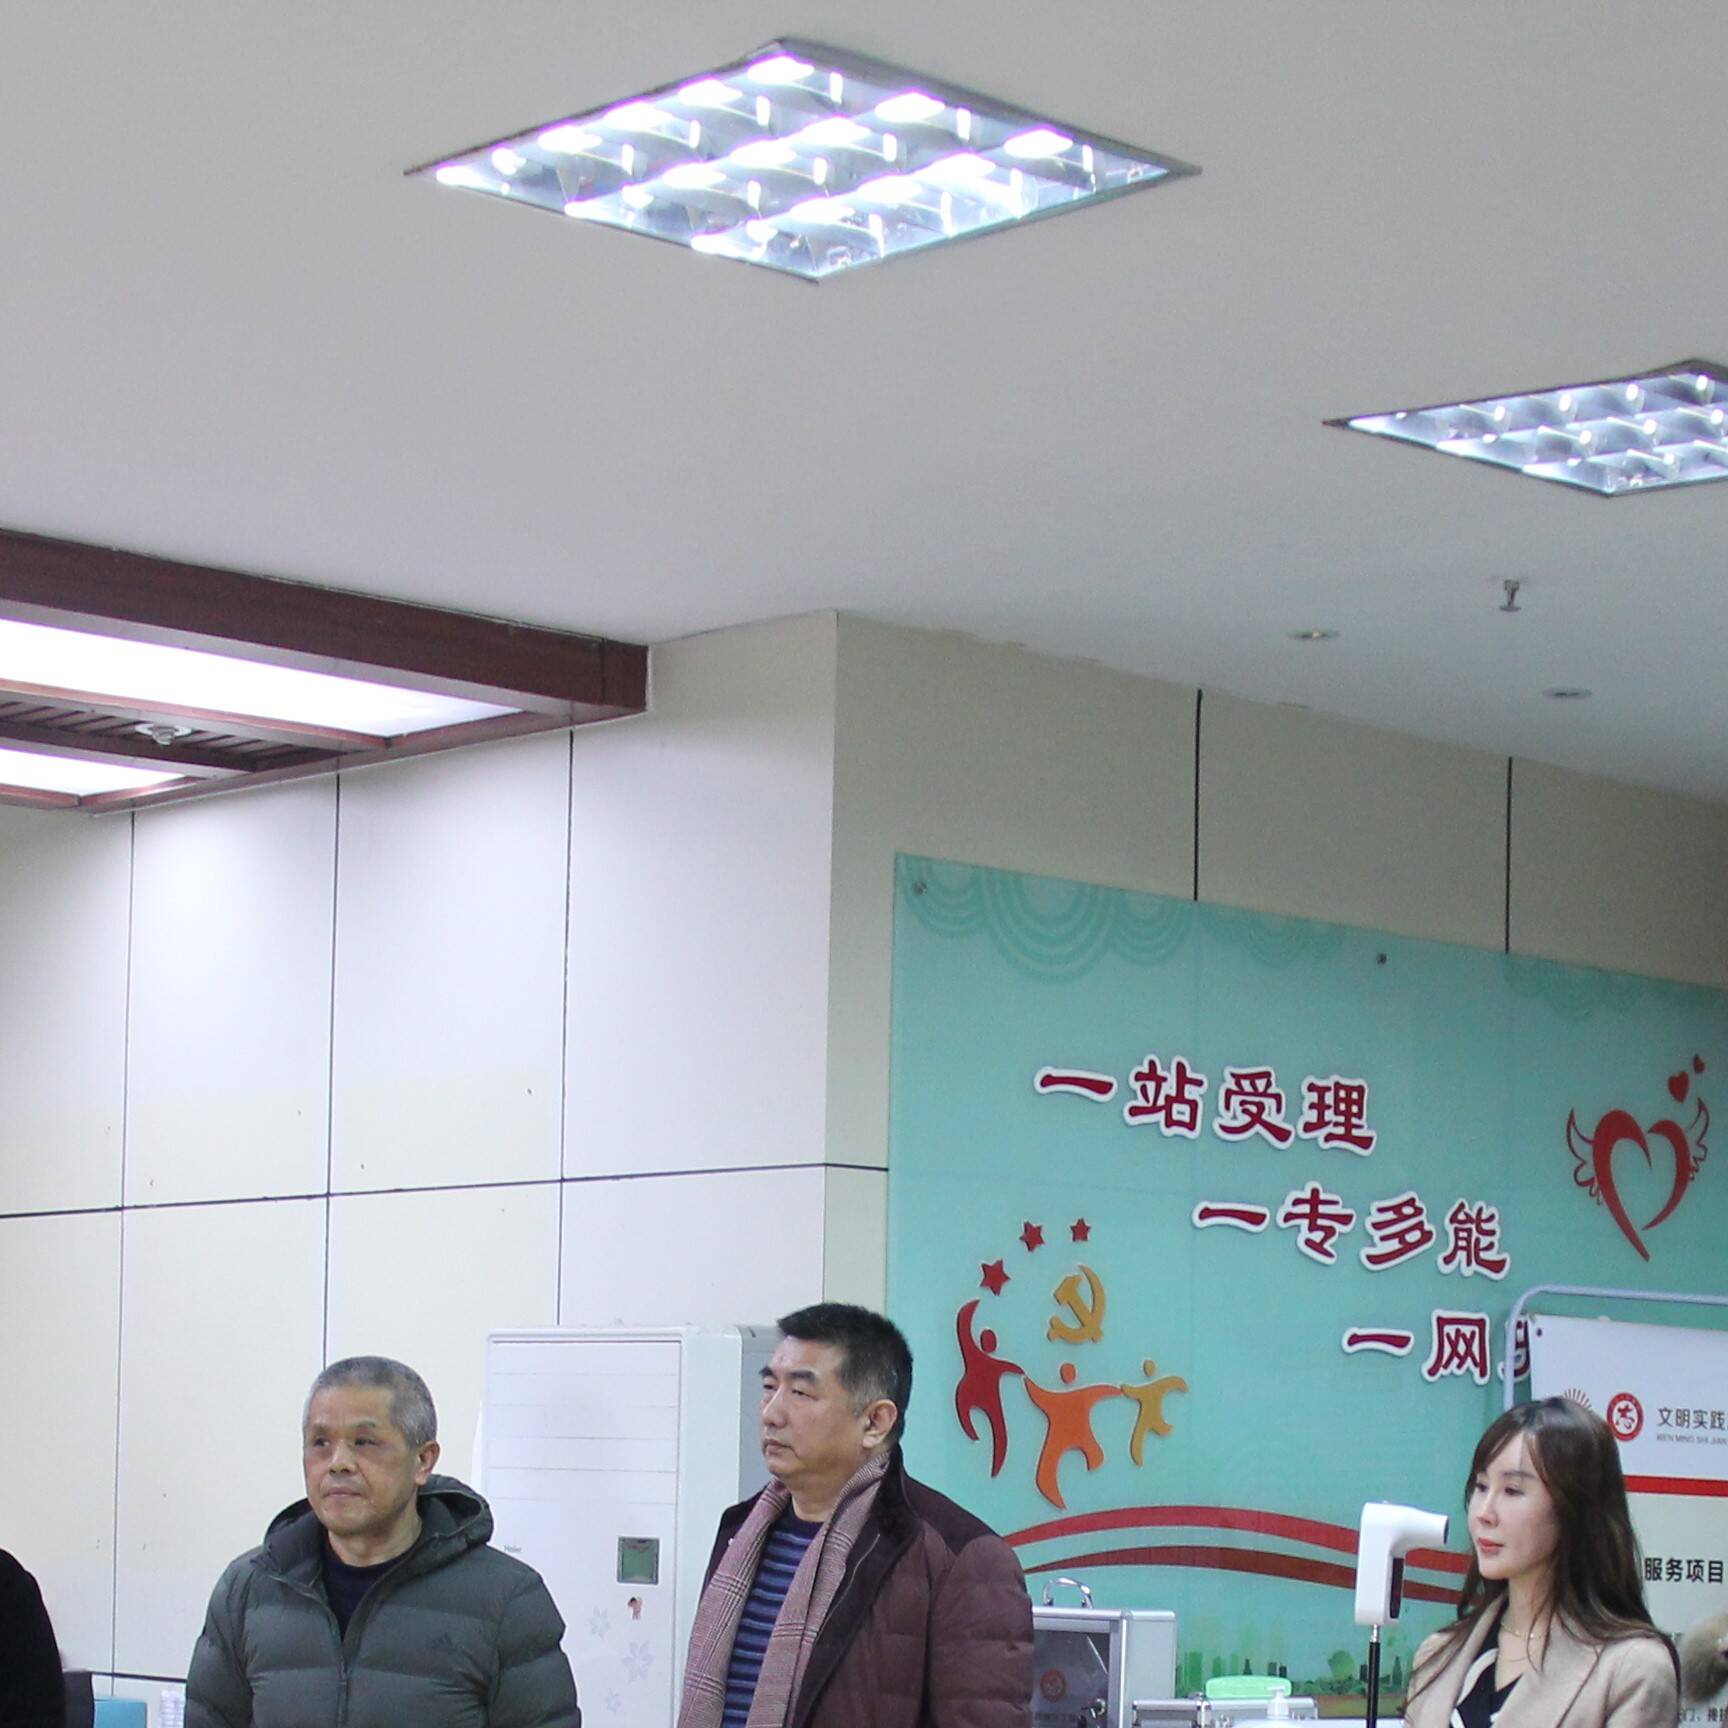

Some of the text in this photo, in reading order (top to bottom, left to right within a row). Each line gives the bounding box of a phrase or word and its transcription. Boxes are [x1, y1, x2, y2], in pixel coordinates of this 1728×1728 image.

[1035, 1055, 1378, 1155] 一站受理
[1192, 1182, 1511, 1280] 一专多能
[1644, 1557, 1724, 1584] 服务项目
